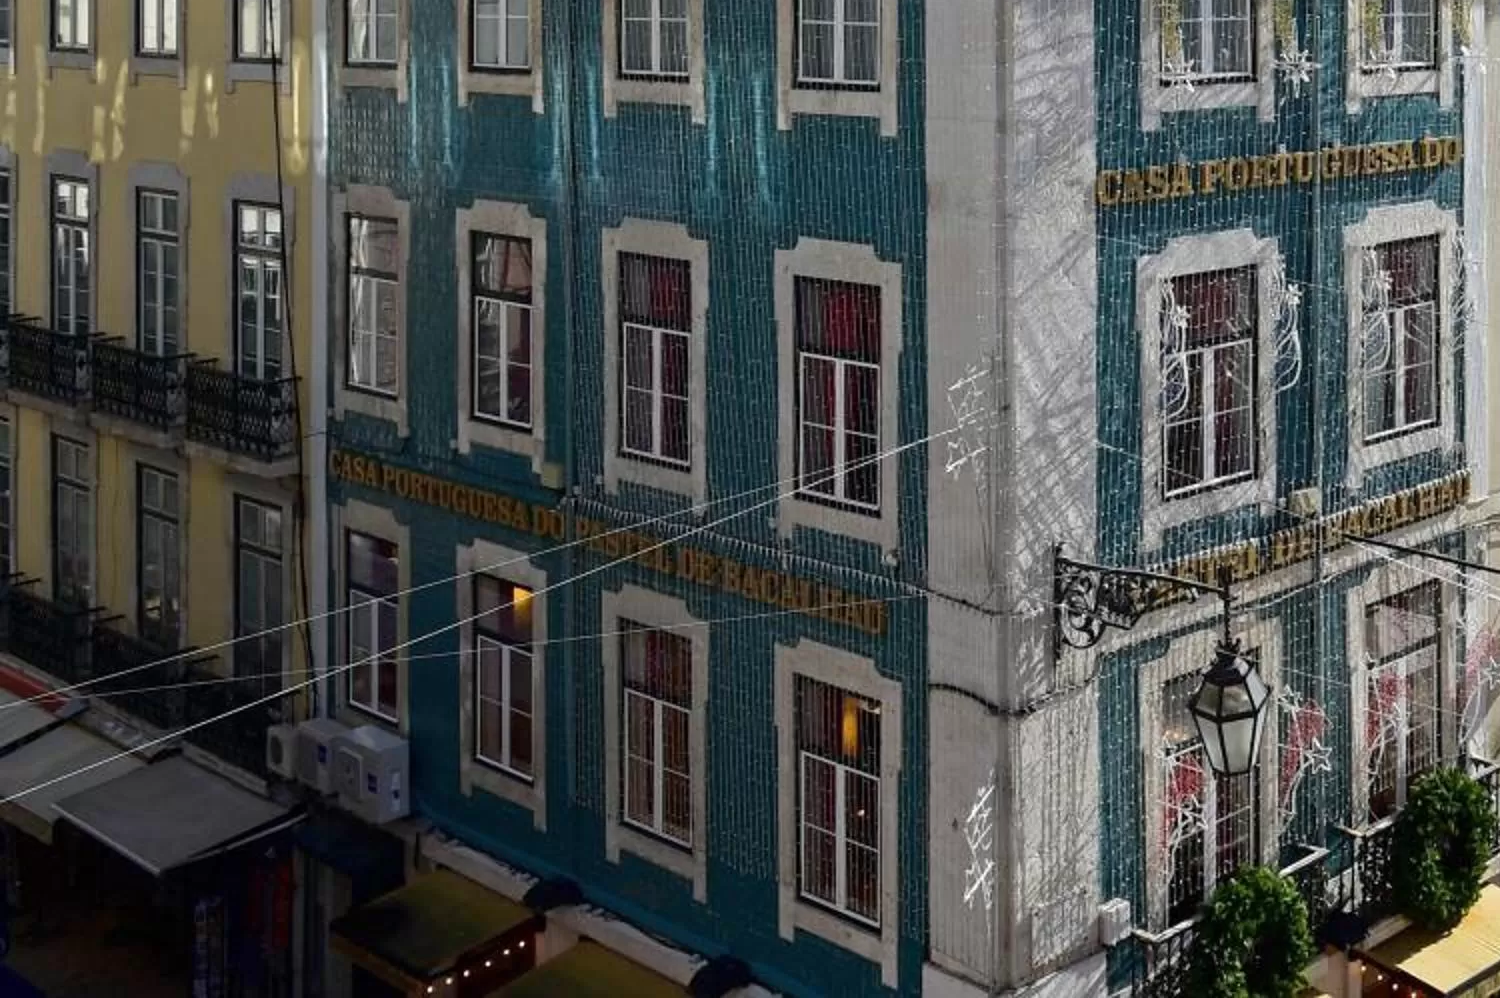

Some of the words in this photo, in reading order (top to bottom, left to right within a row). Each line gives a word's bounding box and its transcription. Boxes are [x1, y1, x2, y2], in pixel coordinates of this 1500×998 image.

[1099, 163, 1194, 202] CASA
[1204, 141, 1415, 192] PORTUGUESA
[1424, 138, 1463, 167] DO
[329, 451, 381, 487] CASA
[382, 464, 529, 530] PORTUGUESA
[534, 505, 566, 539] DO
